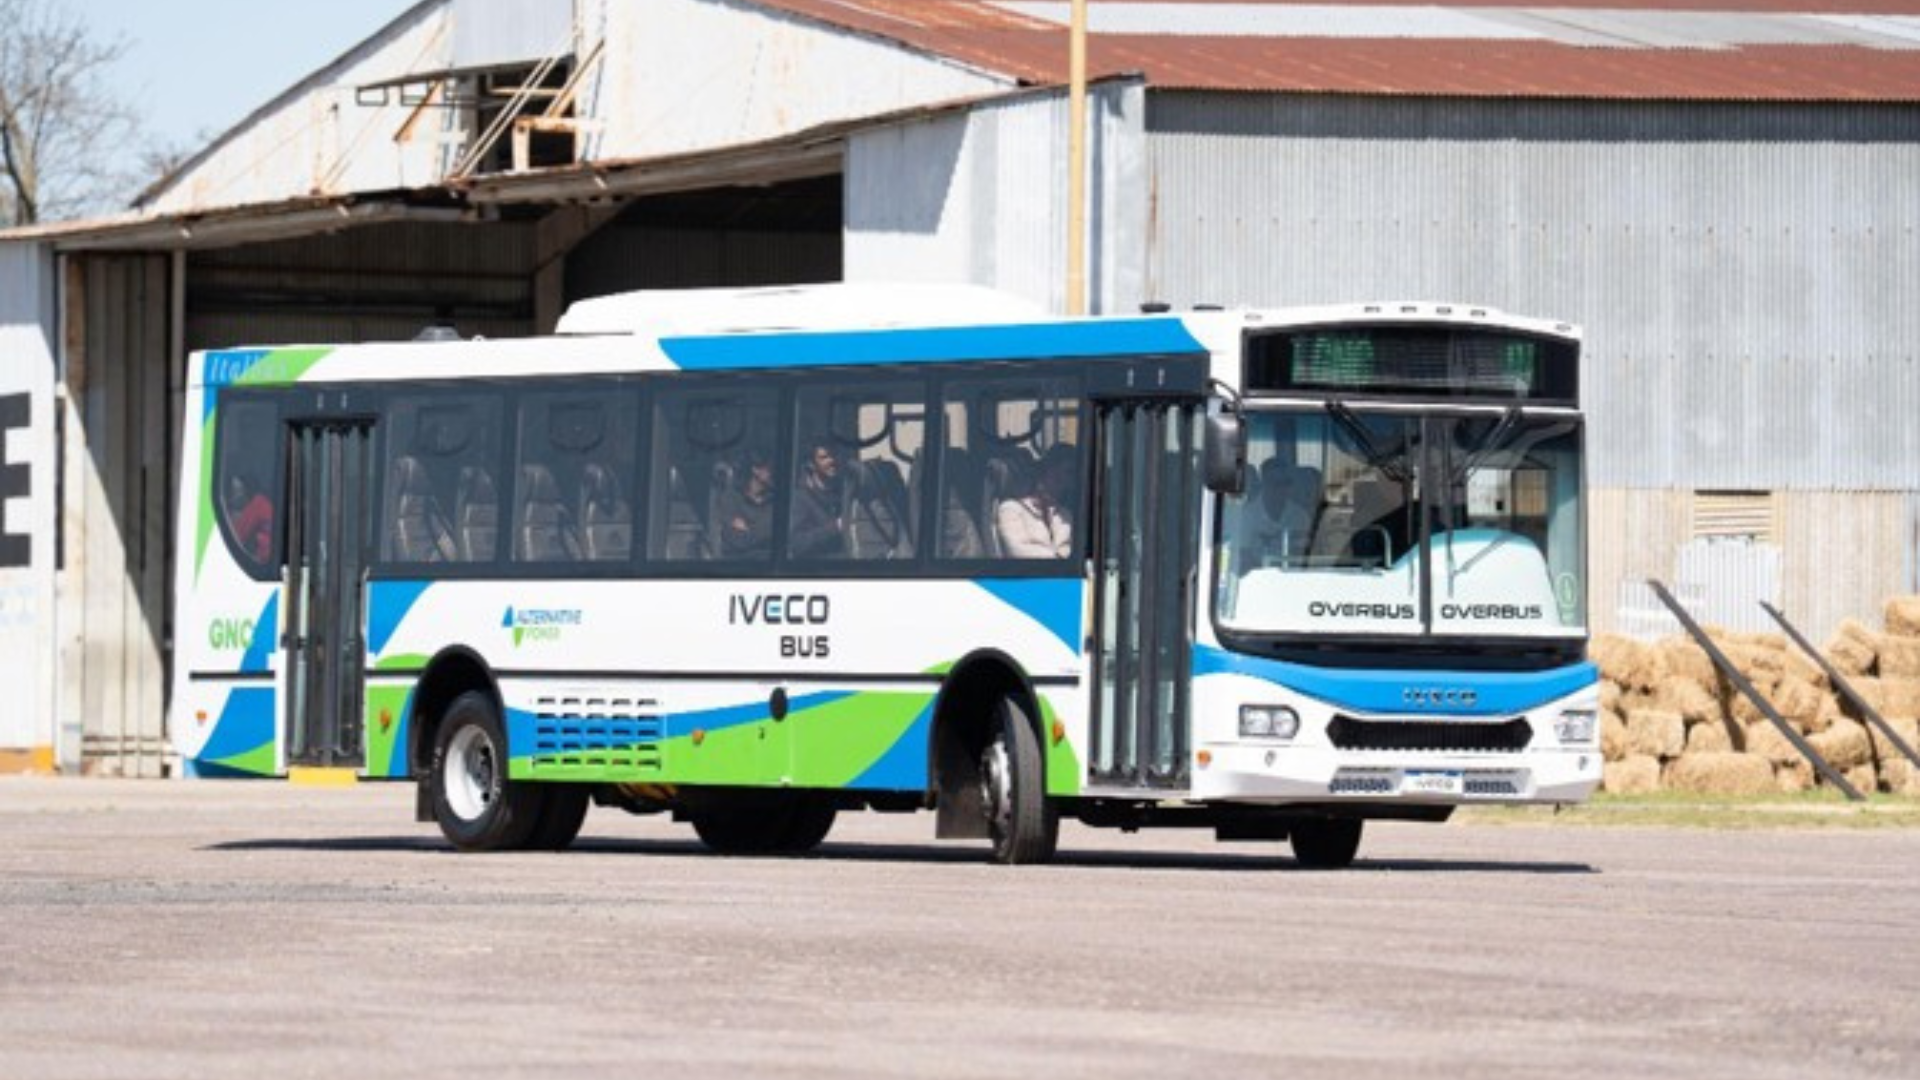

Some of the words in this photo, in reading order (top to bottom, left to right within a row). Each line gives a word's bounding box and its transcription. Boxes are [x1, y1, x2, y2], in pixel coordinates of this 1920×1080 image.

[517, 609, 582, 625] ALTERNATIVE
[729, 595, 829, 625] IVECO
[1309, 601, 1415, 619] OVERBUS
[1441, 604, 1543, 619] OVERBUS
[209, 619, 254, 649] GNC
[780, 636, 830, 657] BUS
[1403, 688, 1477, 706] IVECO
